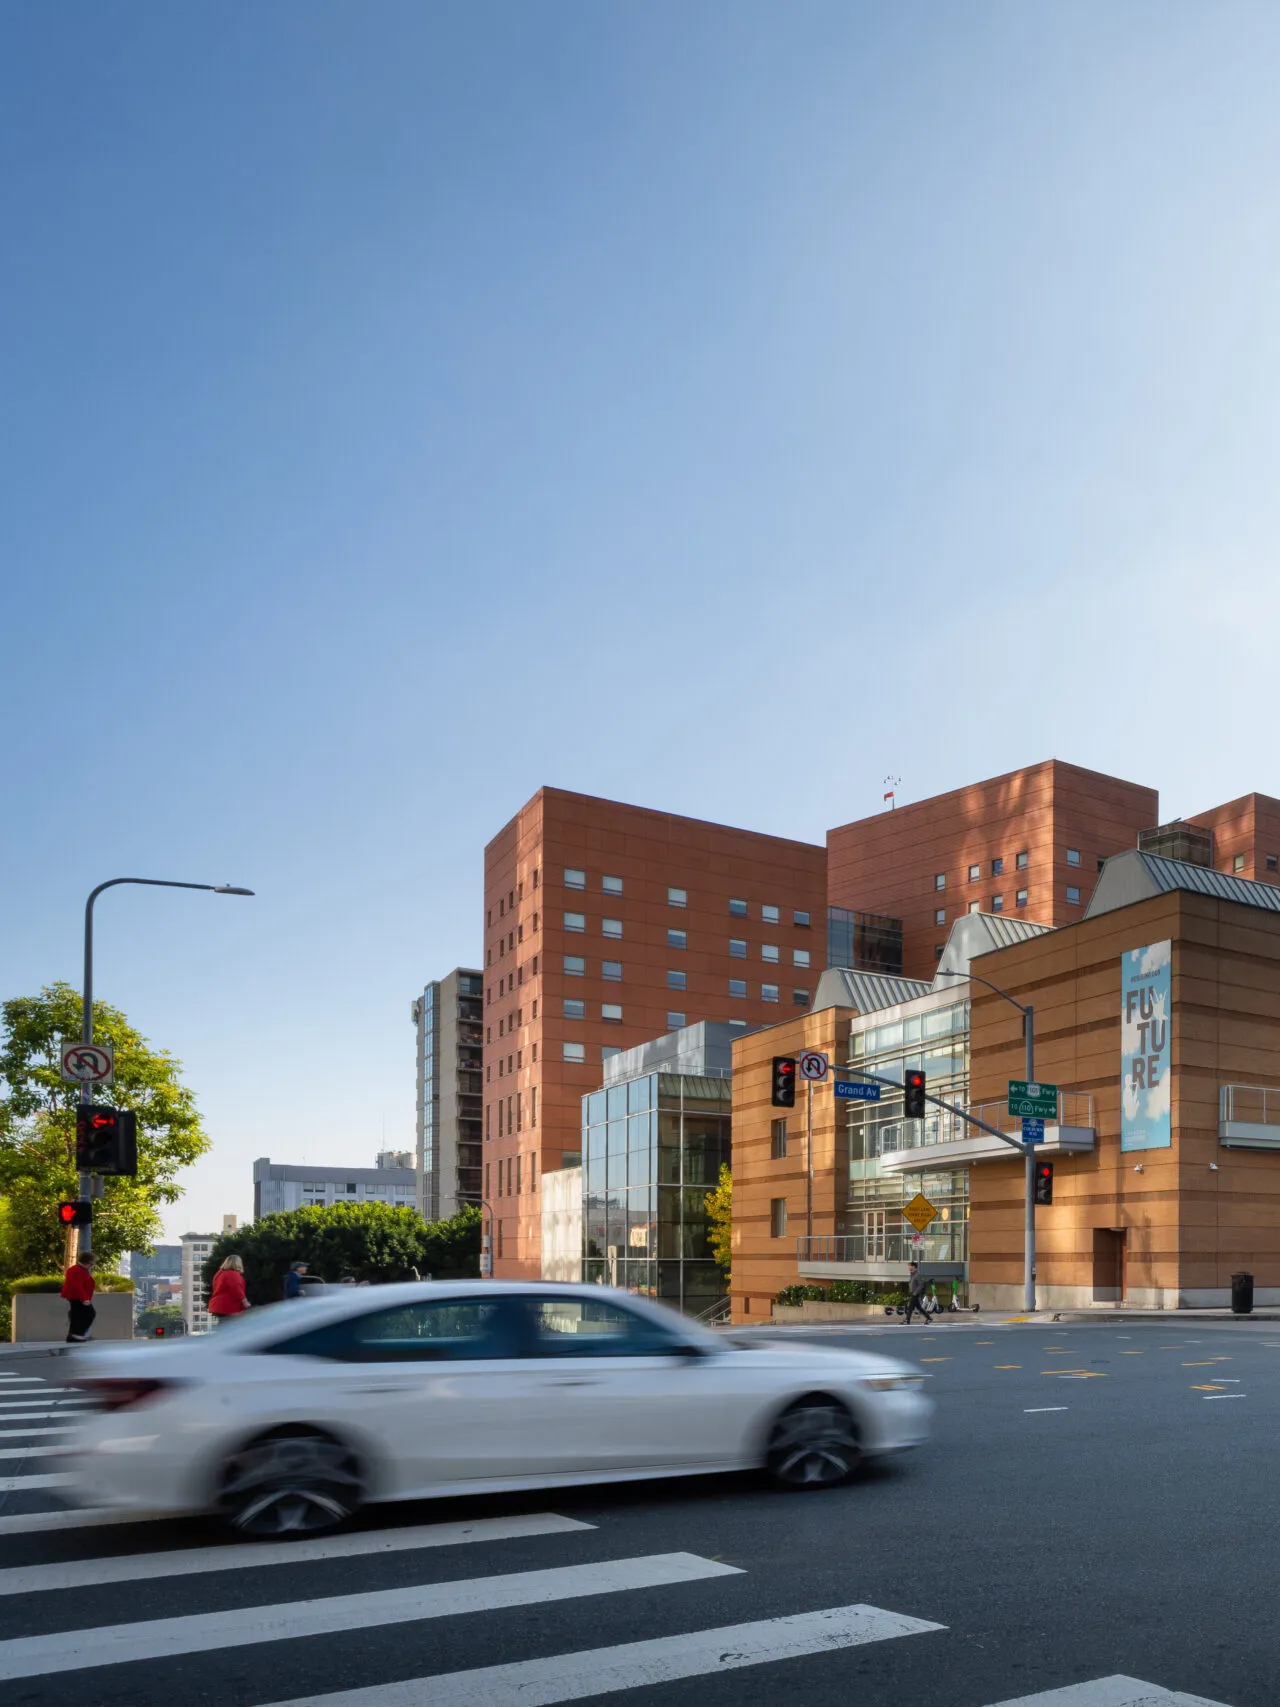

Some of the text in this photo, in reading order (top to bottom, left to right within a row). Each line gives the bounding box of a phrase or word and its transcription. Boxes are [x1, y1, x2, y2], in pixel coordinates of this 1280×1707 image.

[1126, 985, 1154, 1024] FU
[1136, 1019, 1166, 1055] TU
[1132, 1053, 1160, 1091] RE
[838, 1084, 877, 1097] Grand Av
[1029, 1087, 1039, 1095] 101
[1042, 1088, 1056, 1096] Fwy
[1034, 1105, 1048, 1114] Fwy
